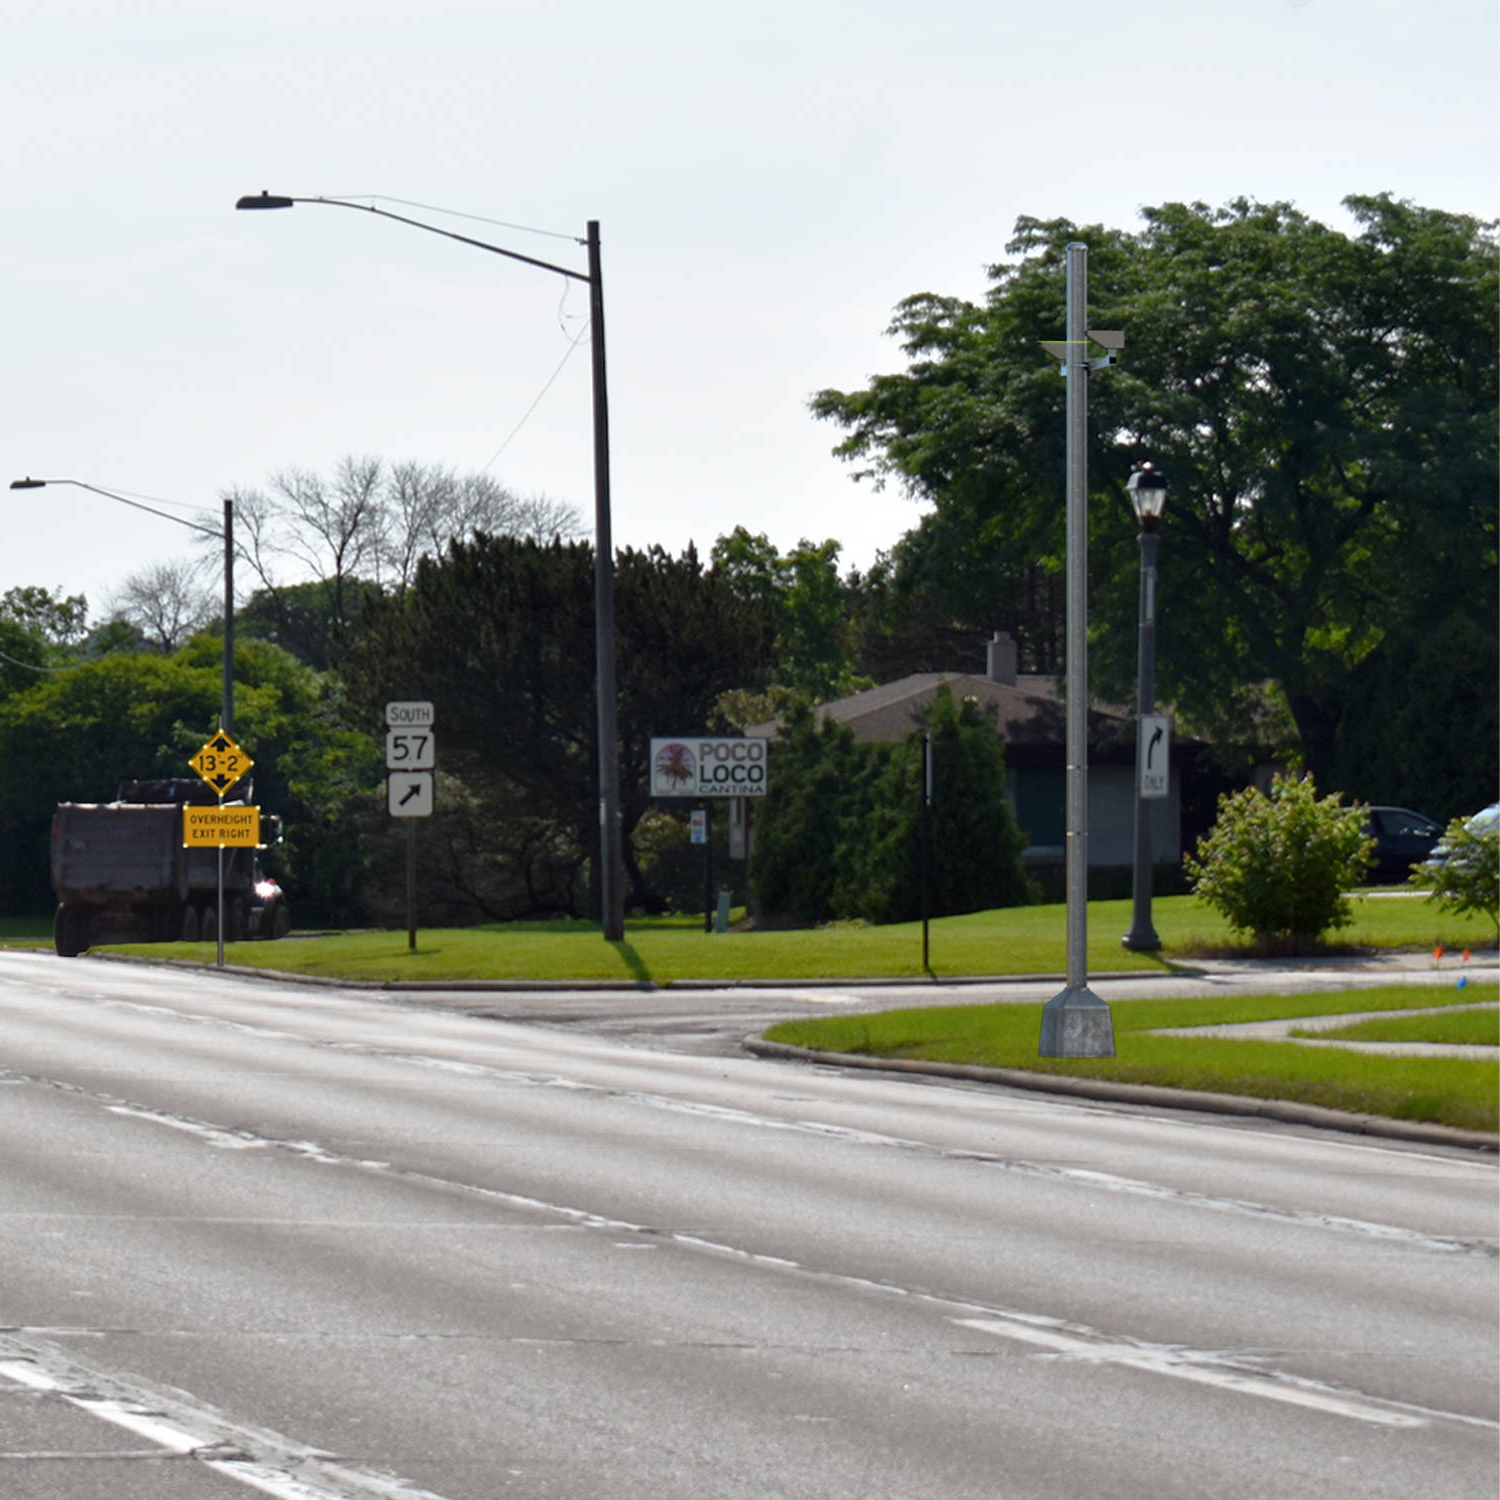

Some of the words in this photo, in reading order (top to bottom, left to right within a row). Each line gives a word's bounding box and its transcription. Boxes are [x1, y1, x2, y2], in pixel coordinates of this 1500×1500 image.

[390, 707, 430, 721] SOUTH
[393, 735, 428, 761] 57
[700, 743, 763, 762] POCO
[701, 764, 764, 783] LOCO
[699, 784, 764, 793] CANTINA
[190, 814, 253, 824] OVERHEIGHT
[192, 829, 215, 839] EXIT
[219, 829, 250, 839] RIGHT
